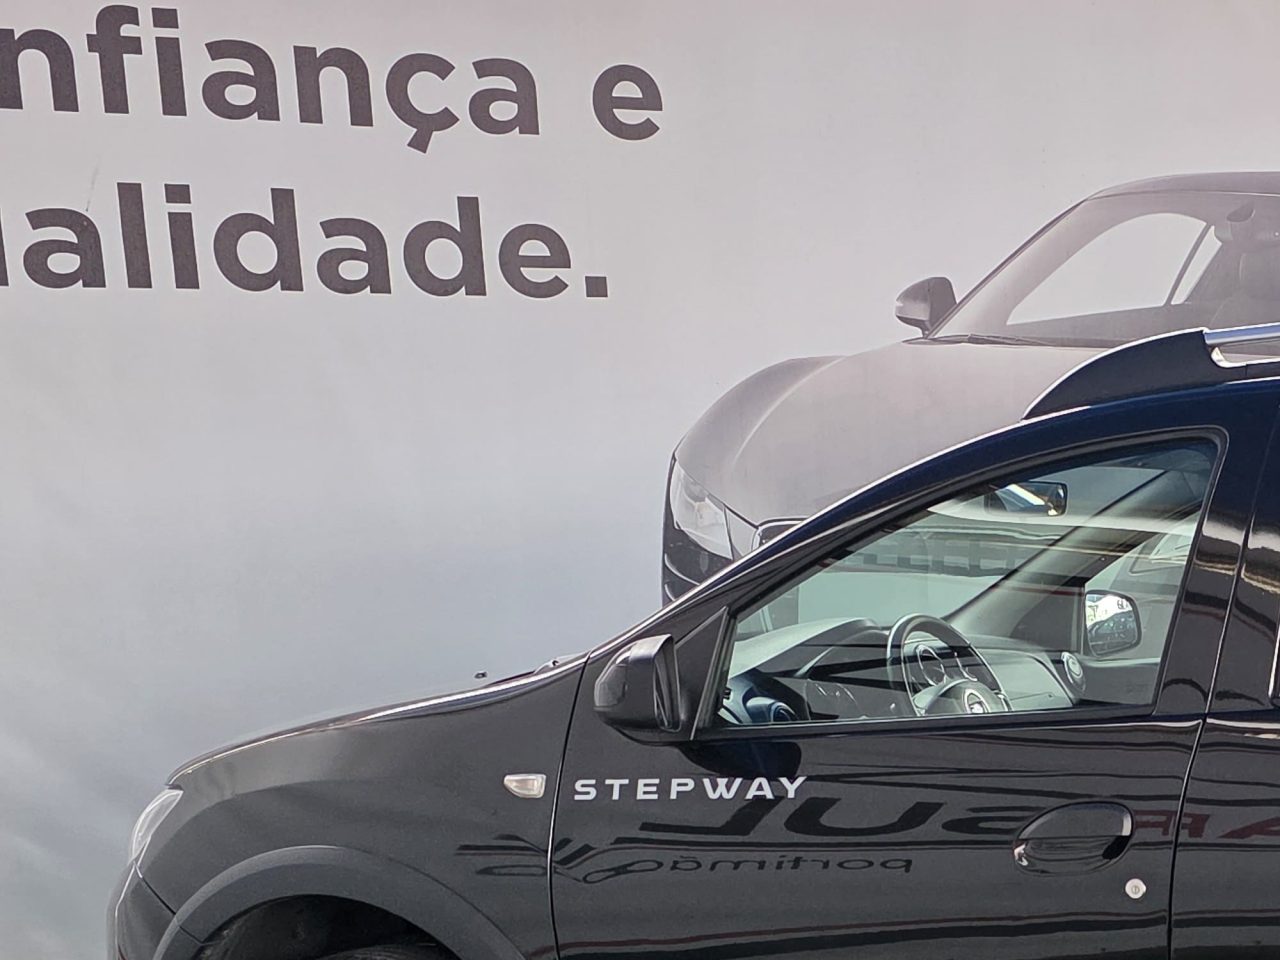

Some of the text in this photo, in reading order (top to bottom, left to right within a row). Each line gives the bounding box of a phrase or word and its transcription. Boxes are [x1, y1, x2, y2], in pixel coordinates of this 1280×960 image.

[0, 4, 663, 154] nfiança e
[0, 181, 608, 298] alidade.
[573, 776, 807, 800] STEPWAY
